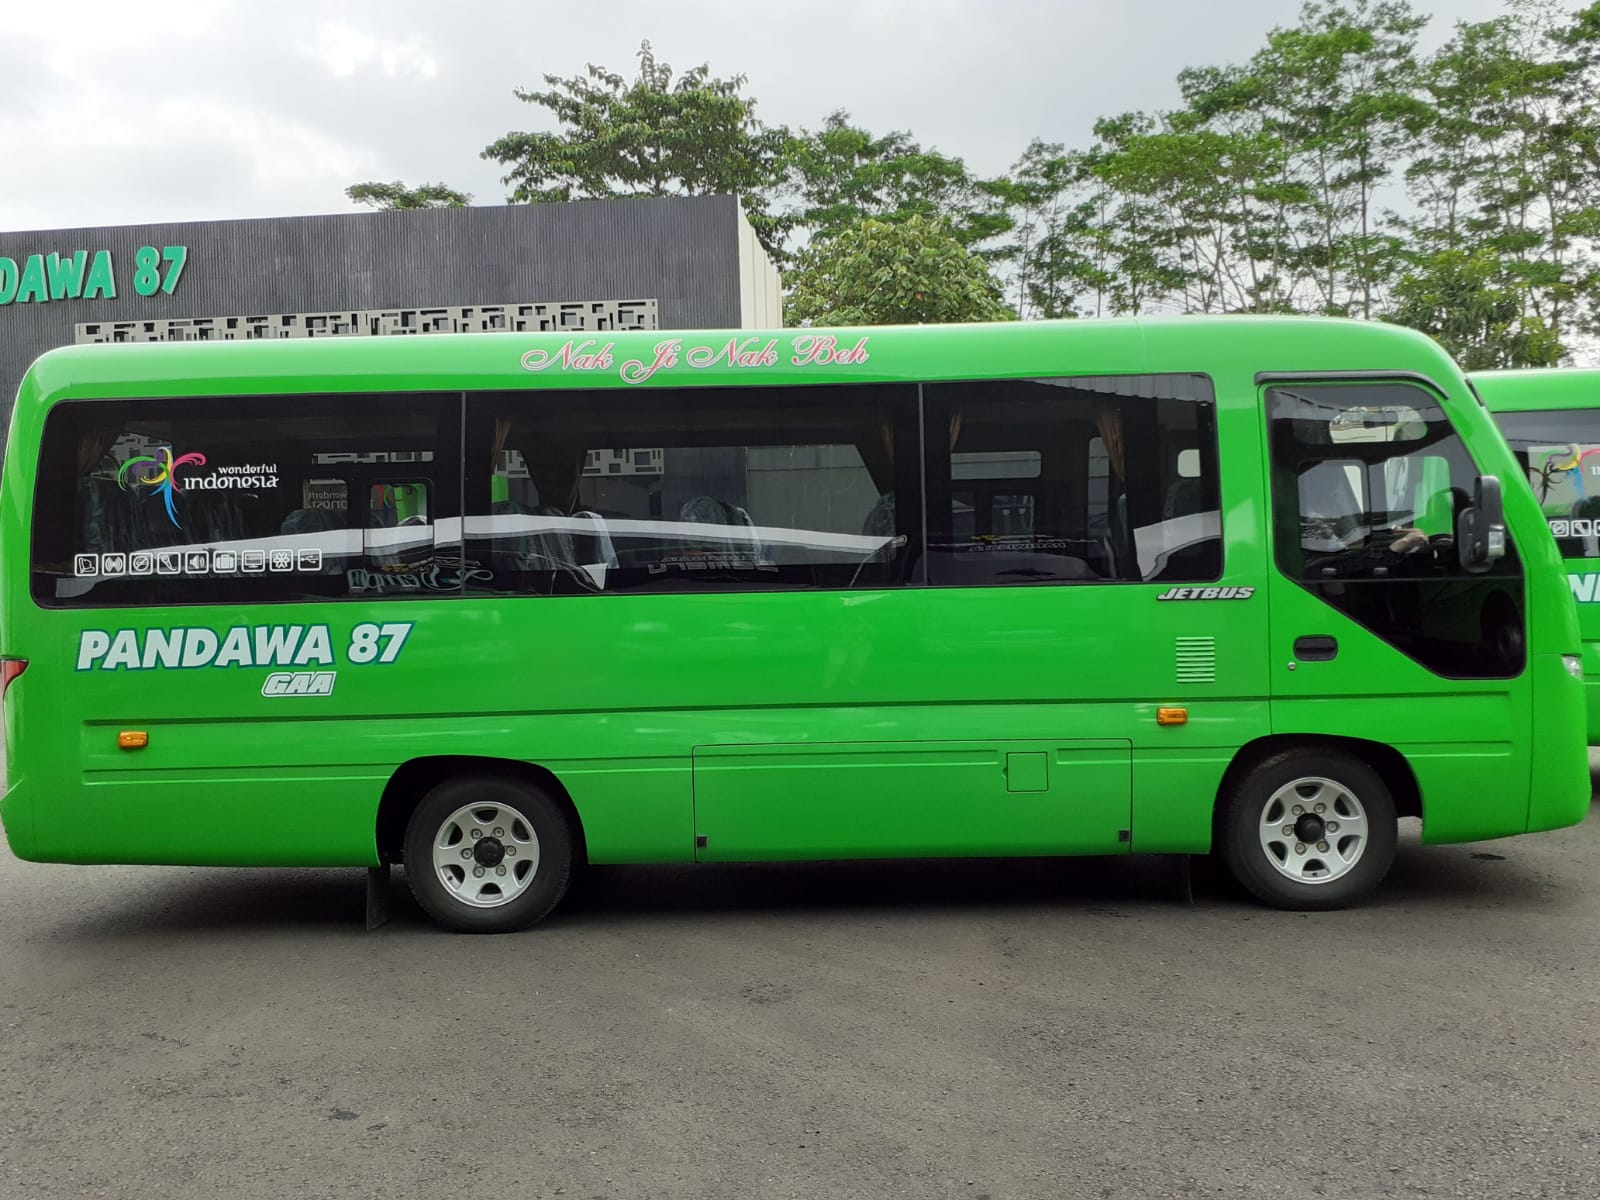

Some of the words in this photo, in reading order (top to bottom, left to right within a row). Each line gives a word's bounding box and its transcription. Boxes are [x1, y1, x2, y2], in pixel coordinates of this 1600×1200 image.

[134, 246, 187, 296] 87
[521, 340, 614, 371] Nak
[687, 336, 778, 368] Nak
[791, 335, 870, 365] Beh
[184, 473, 279, 490] indonesia
[218, 464, 277, 474] wonderful
[1156, 586, 1255, 601] JETBUS
[76, 626, 336, 671] PANDAWA
[346, 621, 415, 664] 87
[261, 671, 337, 697] GAA
